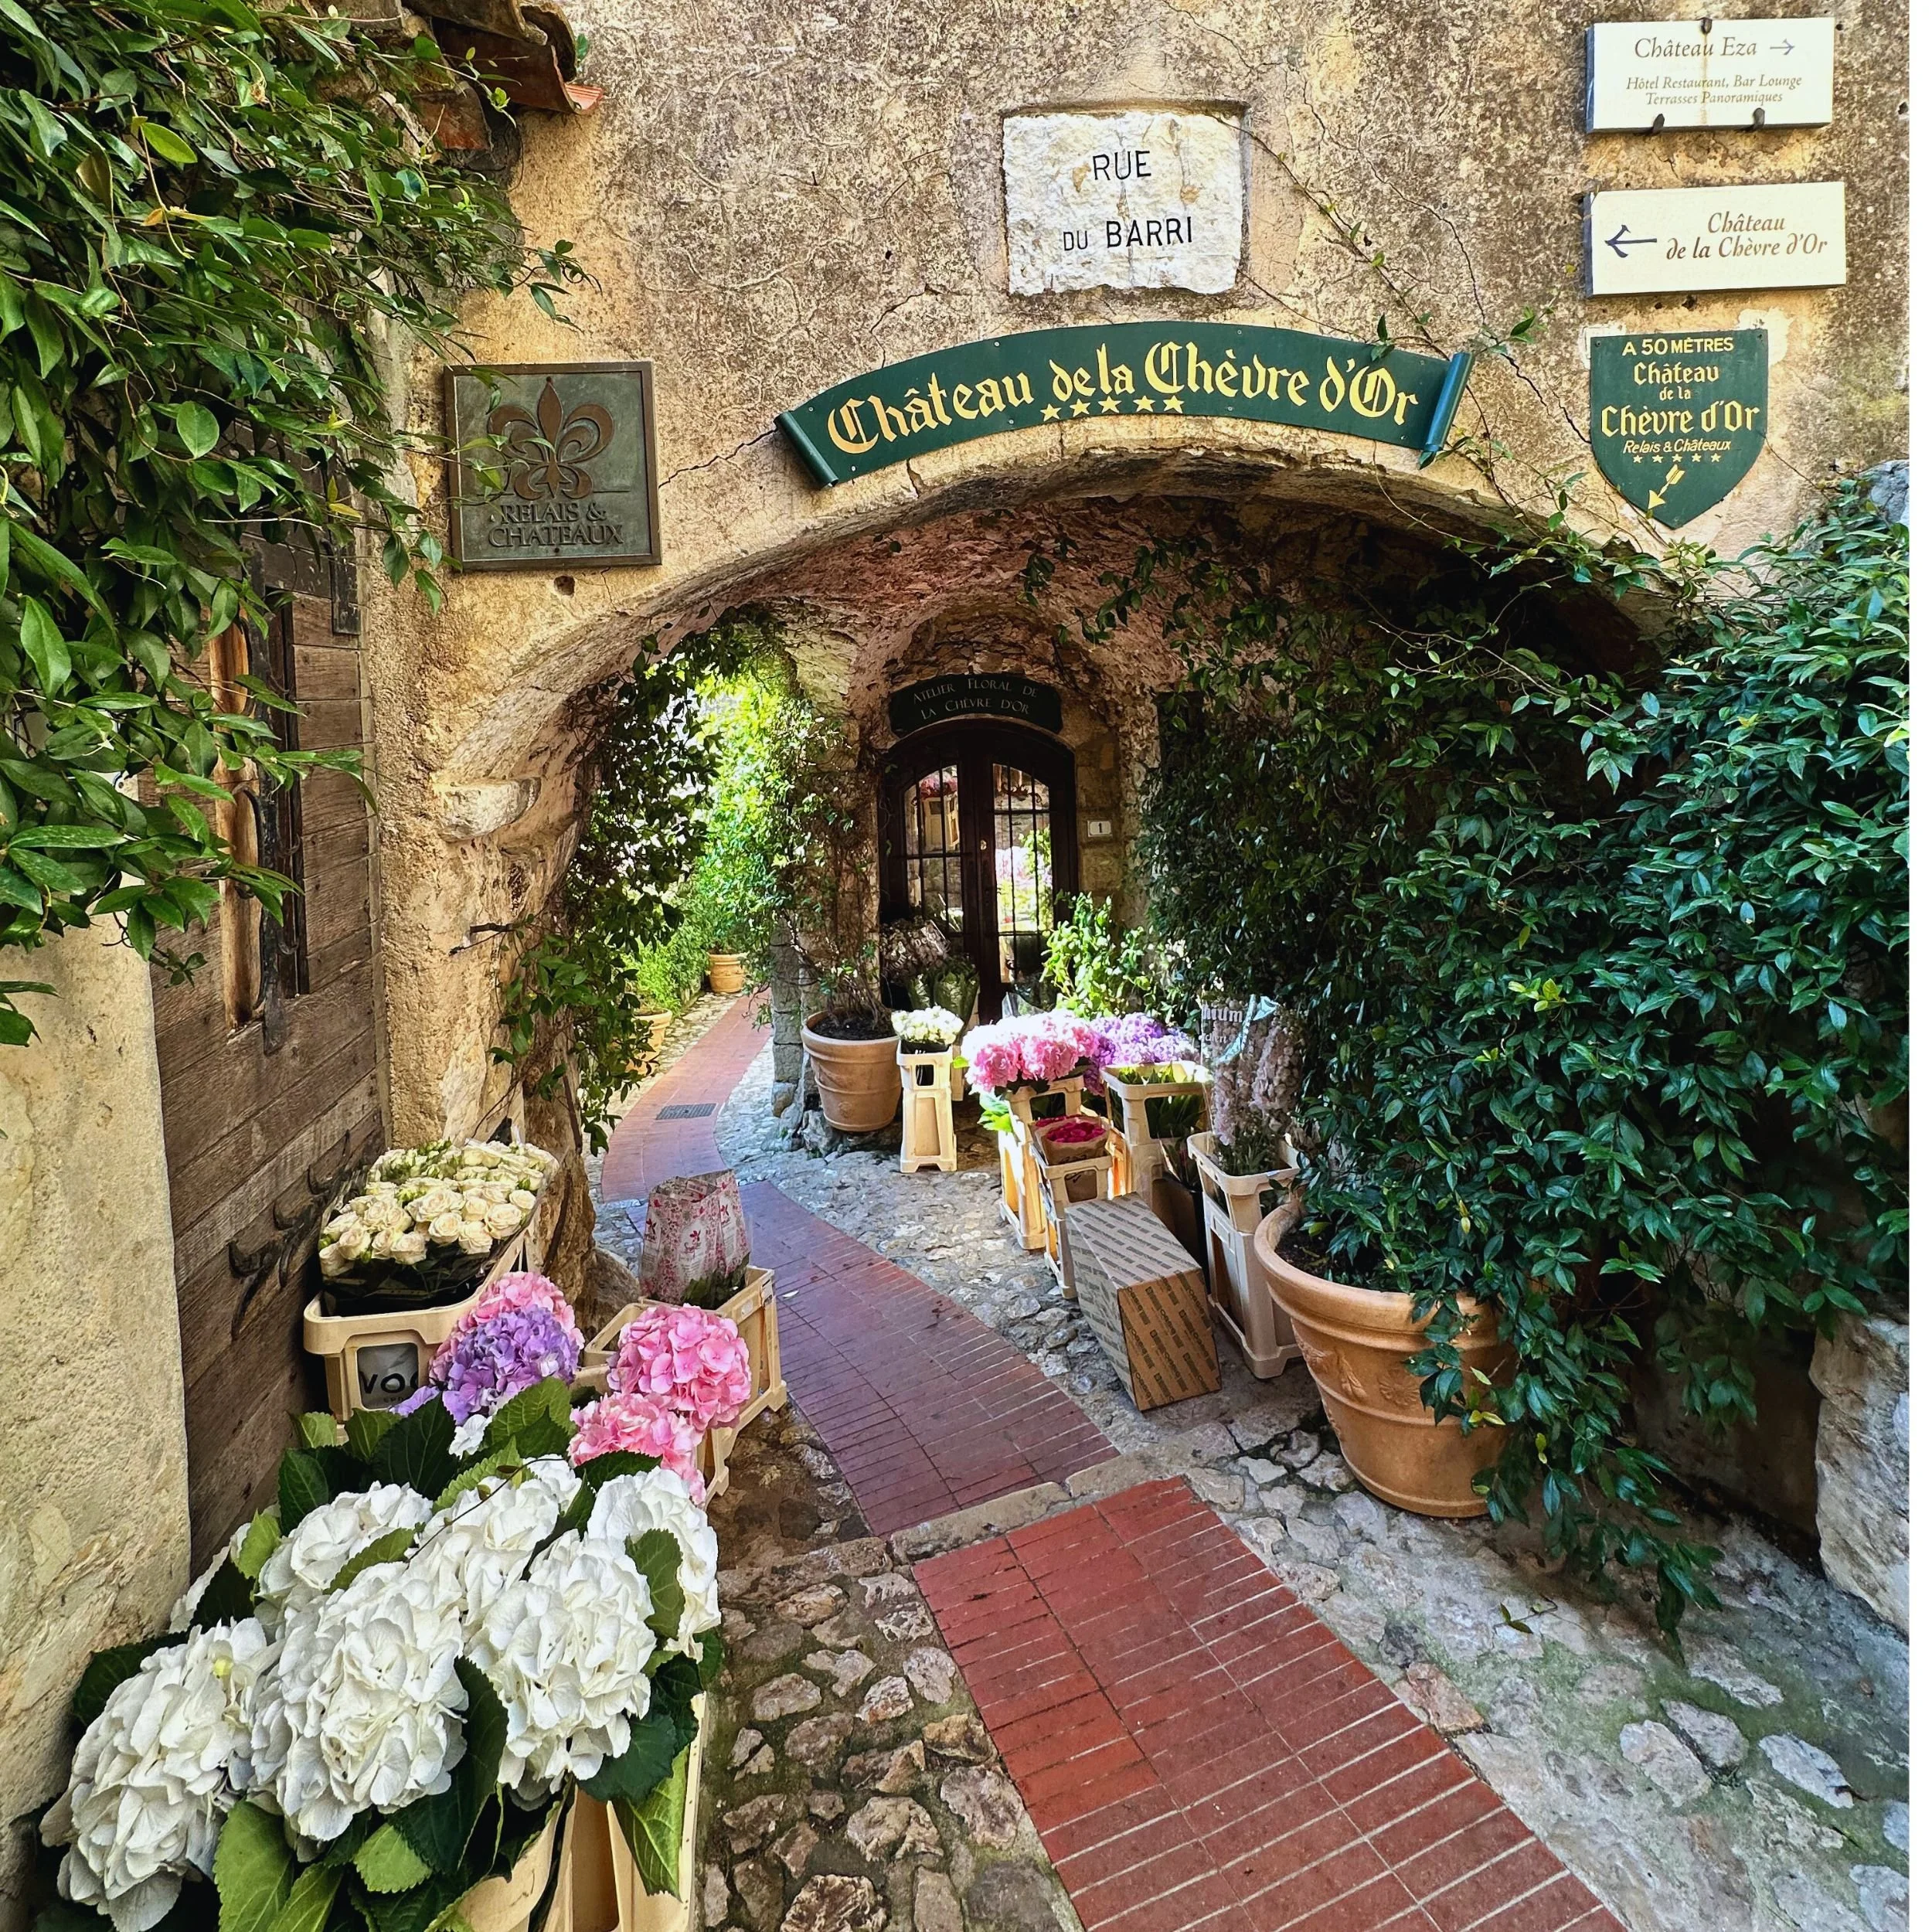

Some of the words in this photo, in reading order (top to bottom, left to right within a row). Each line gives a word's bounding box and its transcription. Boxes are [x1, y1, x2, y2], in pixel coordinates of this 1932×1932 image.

[1634, 36, 1713, 58] Château
[1720, 36, 1757, 57] Eza
[1626, 76, 1659, 90] Hôtel
[1662, 76, 1730, 89] Restaurant,
[1733, 76, 1756, 88] Bar
[1759, 75, 1802, 90] Lounge
[1645, 92, 1697, 105] Terrasses
[1700, 90, 1783, 107] Panoramiques
[1092, 150, 1151, 181] RUE
[1708, 210, 1786, 233] Château
[1063, 230, 1088, 251] DU
[1106, 216, 1192, 248] BARRI
[1666, 237, 1686, 260] de
[1692, 236, 1712, 259] la
[1719, 236, 1781, 258] Chèvre
[1786, 233, 1828, 255] d'Or
[1622, 341, 1637, 356] A
[1641, 338, 1668, 355] 50
[1634, 361, 1719, 386] Château
[826, 371, 1035, 454] Château
[1144, 341, 1311, 407] Chèvre
[1318, 355, 1420, 427] d'Or
[1659, 386, 1674, 402] de
[1677, 386, 1692, 400] la
[1601, 404, 1694, 437] Chèvre
[1701, 400, 1760, 433] d'Or
[1623, 440, 1661, 454] Relais
[1663, 441, 1672, 453] &
[1674, 438, 1732, 452] Châteaux
[501, 502, 580, 525] RELAIS
[587, 502, 607, 522] &
[913, 683, 956, 705] ATELIER
[968, 677, 1012, 692] FLORAL
[1022, 685, 1037, 698] DE
[920, 709, 937, 720] LA
[945, 697, 992, 713] CHÈVRE
[1001, 699, 1030, 715] D'OR
[1098, 821, 1103, 834] 1
